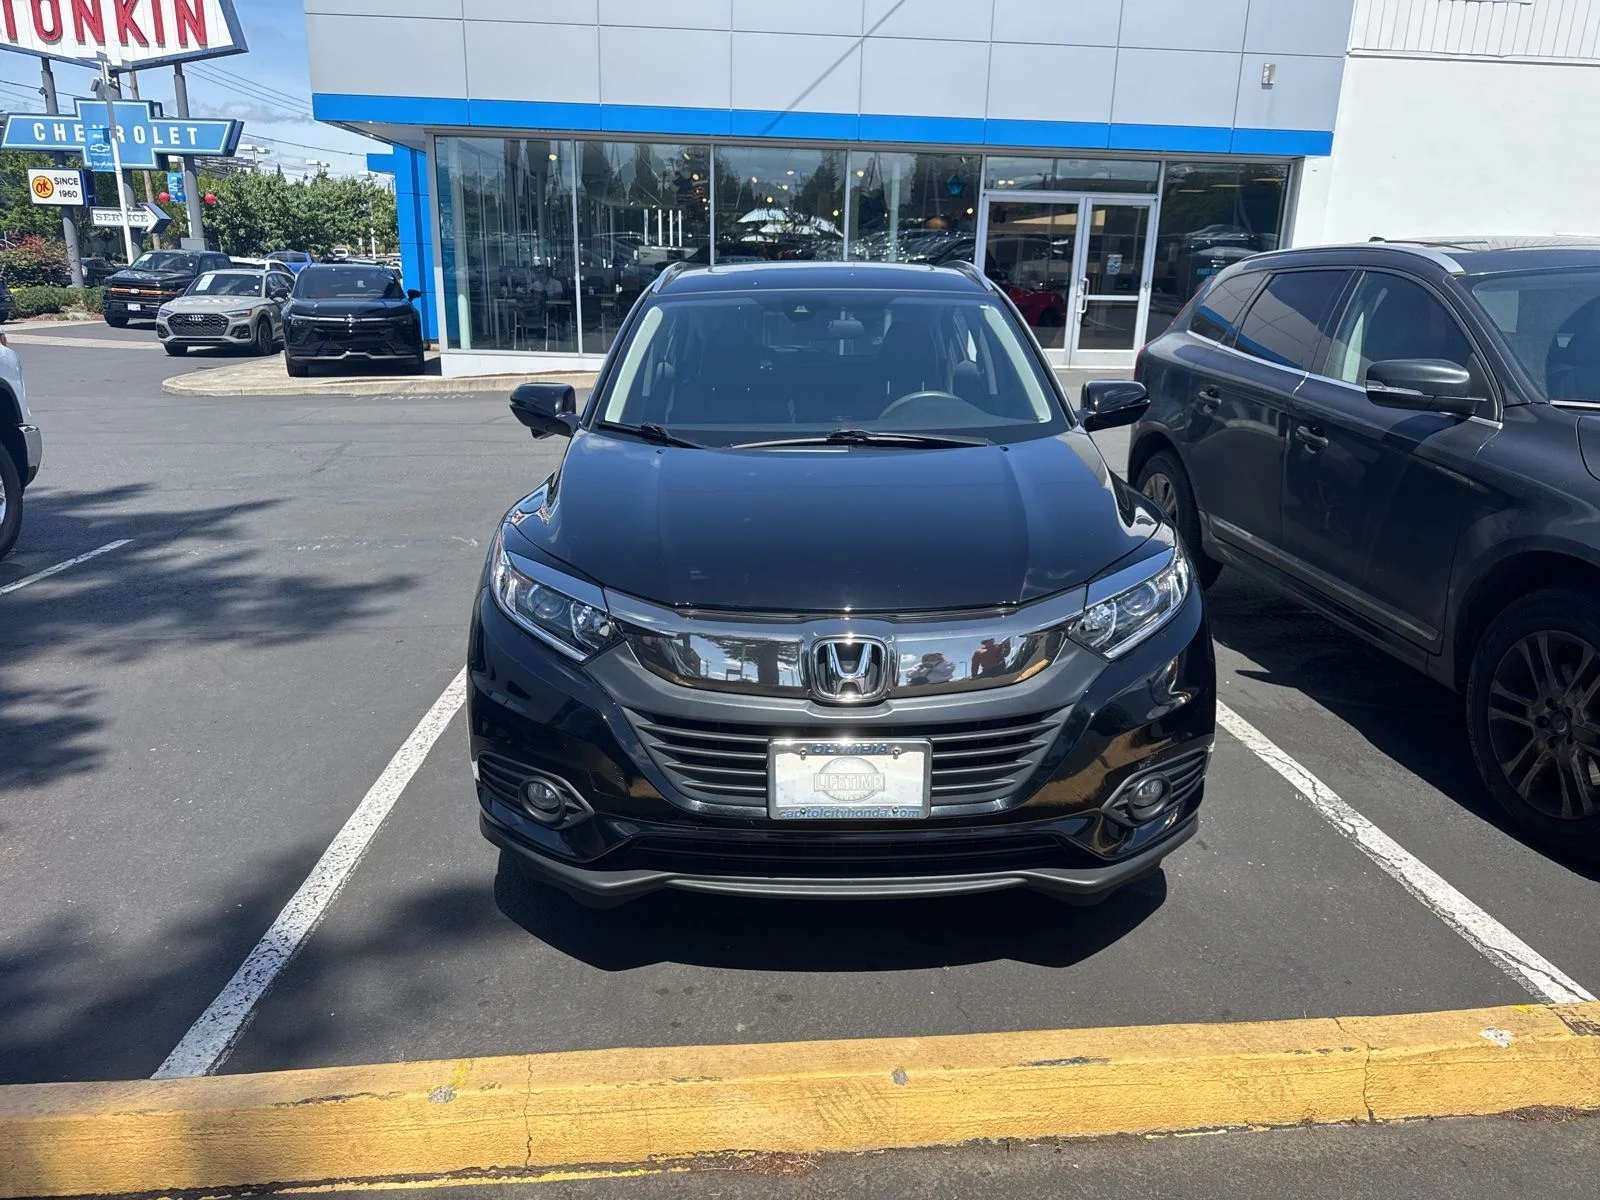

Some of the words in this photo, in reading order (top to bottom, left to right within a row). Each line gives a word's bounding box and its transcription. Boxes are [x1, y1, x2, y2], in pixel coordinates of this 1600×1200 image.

[33, 122, 198, 146] CHEROLET
[36, 180, 50, 194] OK
[53, 177, 79, 186] SINCE
[58, 190, 78, 198] 1960
[811, 743, 888, 754] OLYMPIA
[816, 774, 882, 791] LIFETIME
